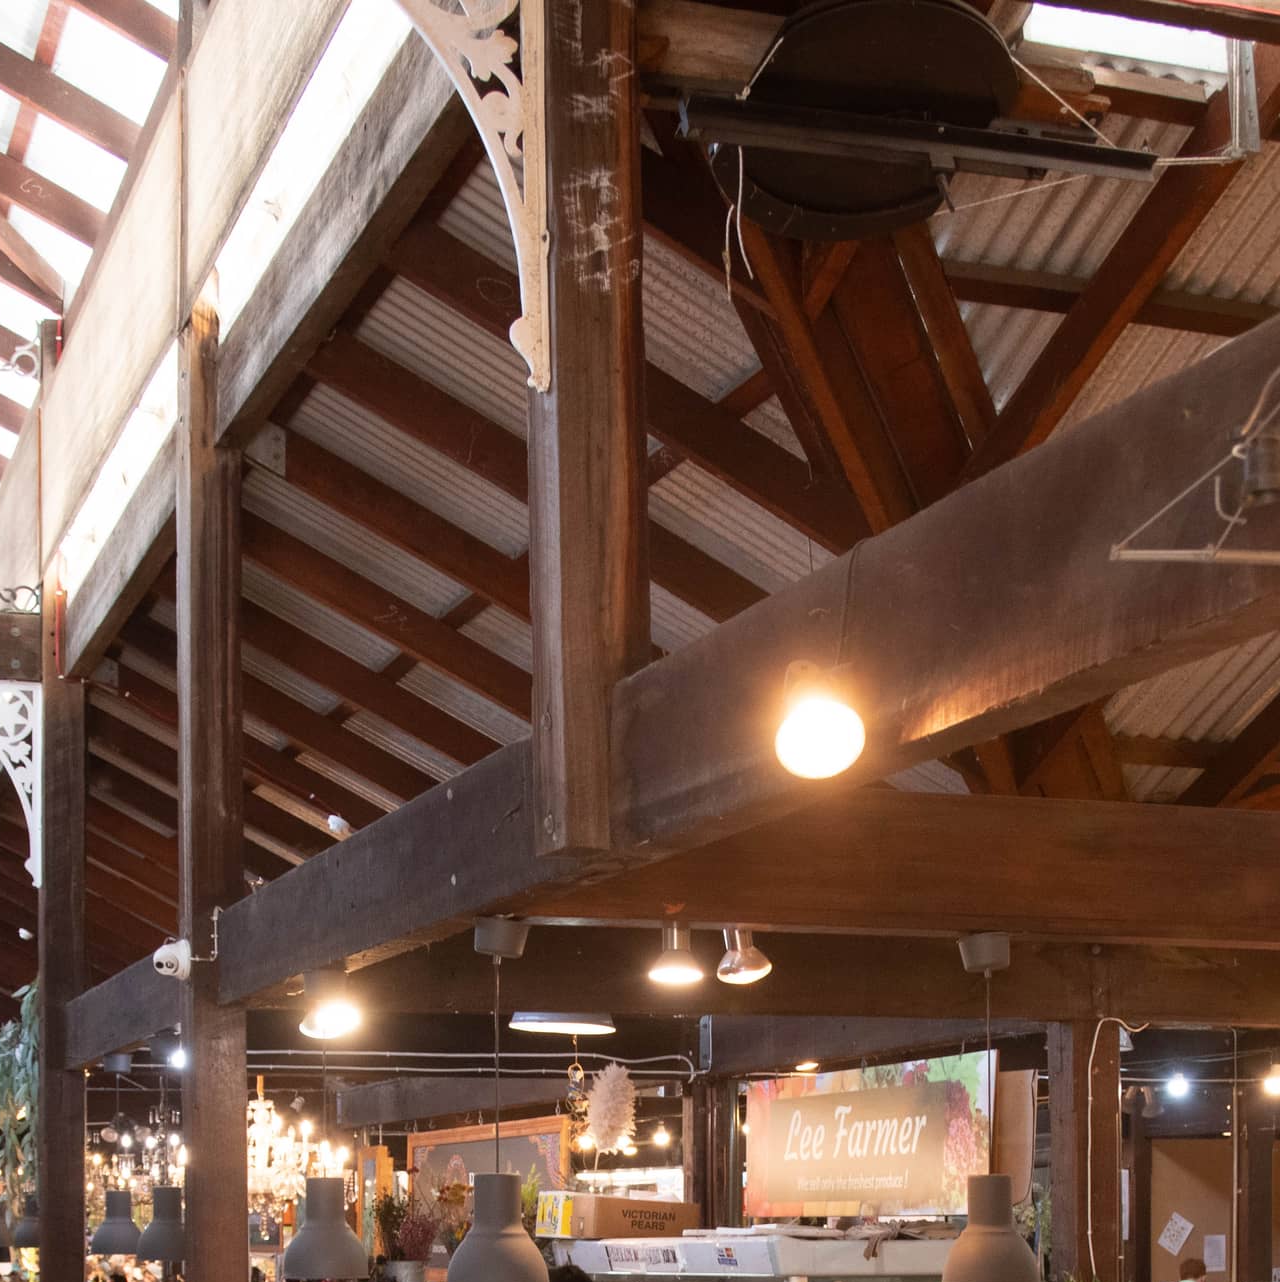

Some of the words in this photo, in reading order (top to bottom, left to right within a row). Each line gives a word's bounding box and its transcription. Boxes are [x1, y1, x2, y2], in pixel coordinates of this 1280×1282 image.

[784, 1109, 825, 1161] Lee
[833, 1104, 928, 1158] Farmer
[622, 1209, 676, 1222] VICTORIAN
[631, 1220, 666, 1232] PEARS
